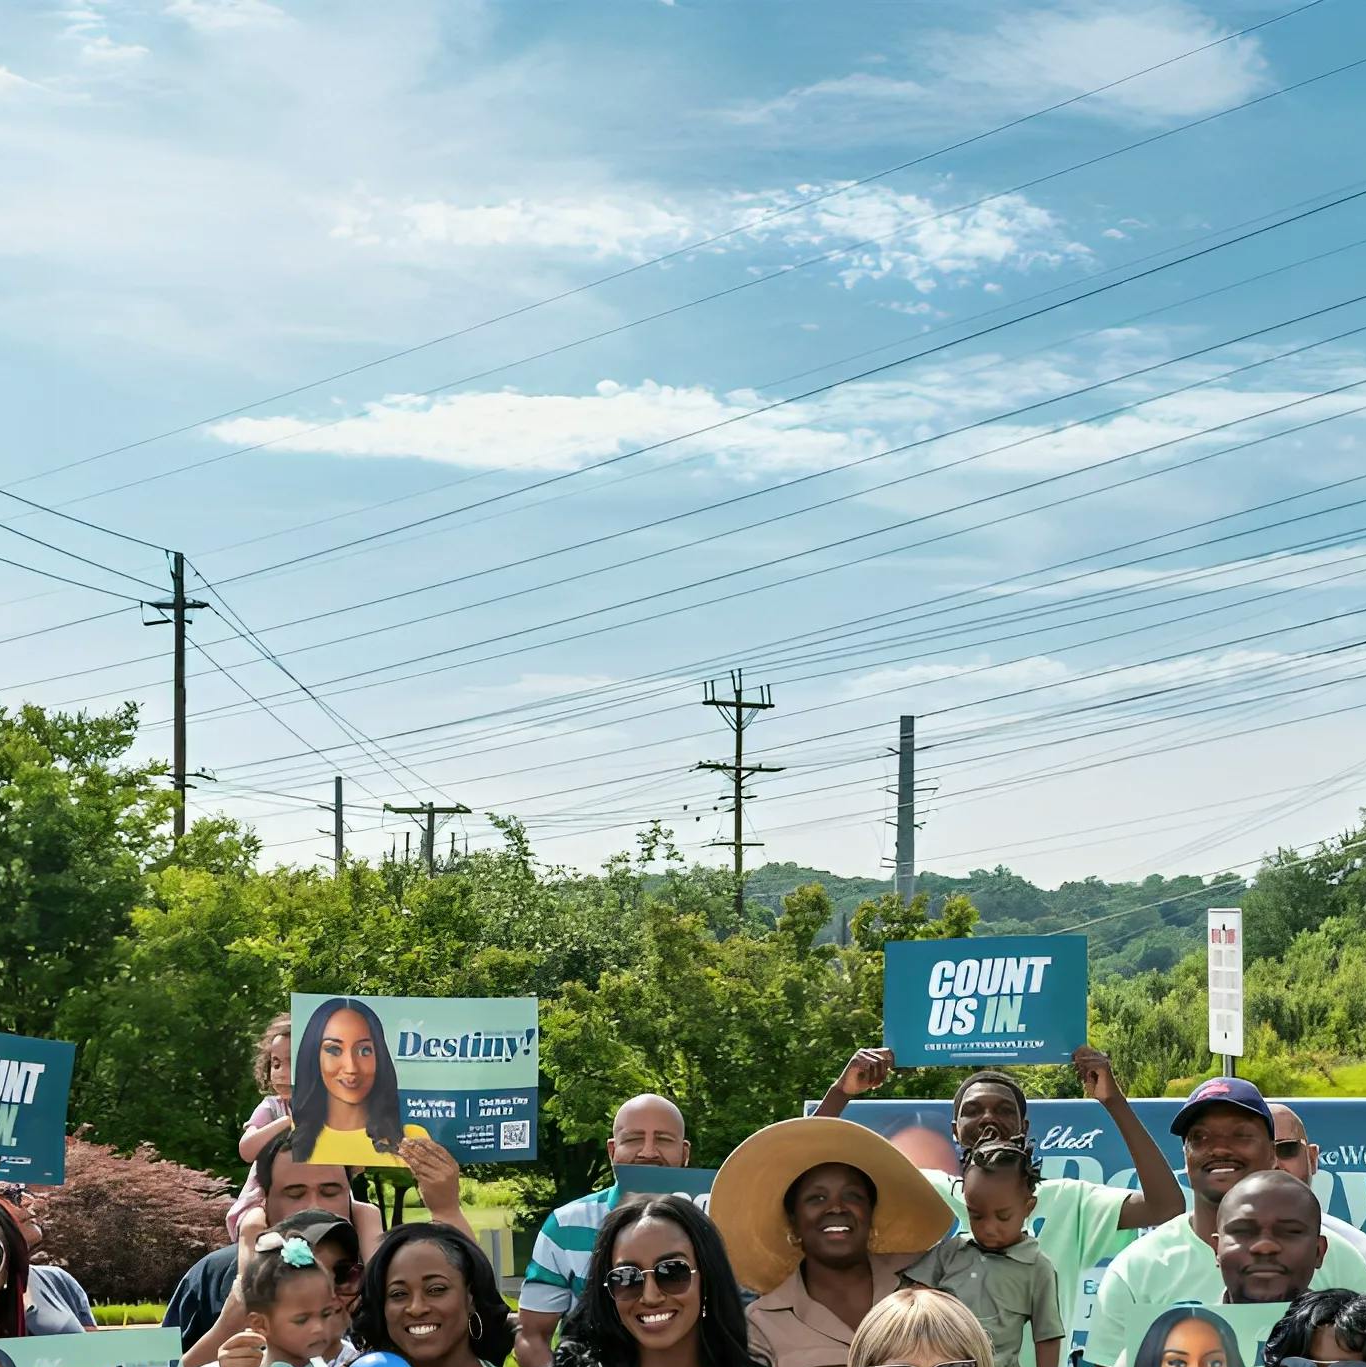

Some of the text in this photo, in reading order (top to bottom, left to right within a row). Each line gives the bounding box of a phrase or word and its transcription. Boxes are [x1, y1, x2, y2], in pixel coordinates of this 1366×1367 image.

[928, 957, 1052, 998] COUNT
[928, 995, 1026, 1036] US IN.
[397, 1028, 535, 1062] Destiny!
[1040, 1125, 1103, 1150] Elect
